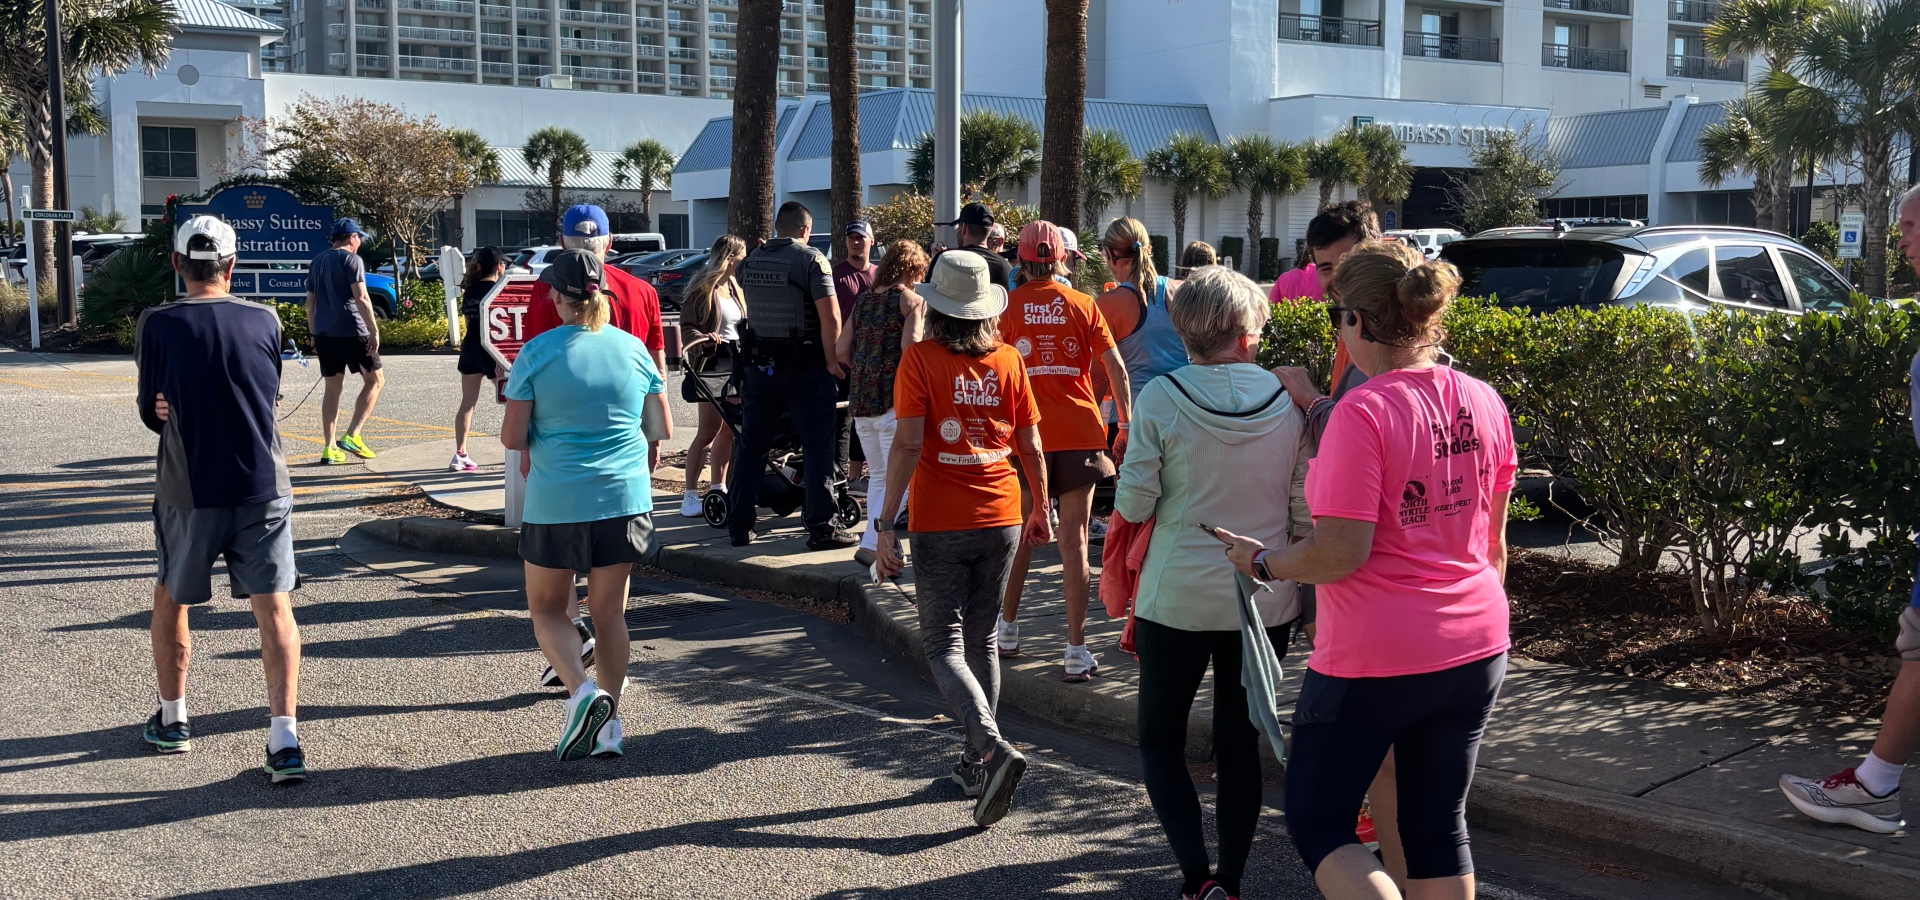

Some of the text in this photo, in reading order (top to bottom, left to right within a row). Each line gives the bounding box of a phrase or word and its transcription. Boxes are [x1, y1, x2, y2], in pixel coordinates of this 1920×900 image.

[269, 213, 322, 230] Suites
[237, 236, 310, 252] istration
[268, 278, 302, 288] Coastal
[1024, 302, 1051, 314] First
[489, 307, 528, 341] ST
[1024, 313, 1067, 325] Strides
[953, 391, 1000, 406] Strides
[1400, 498, 1428, 510] NORTH
[1434, 503, 1453, 513] FLEET
[1399, 505, 1431, 519] MYRTLE
[1400, 514, 1427, 527] BEACH
